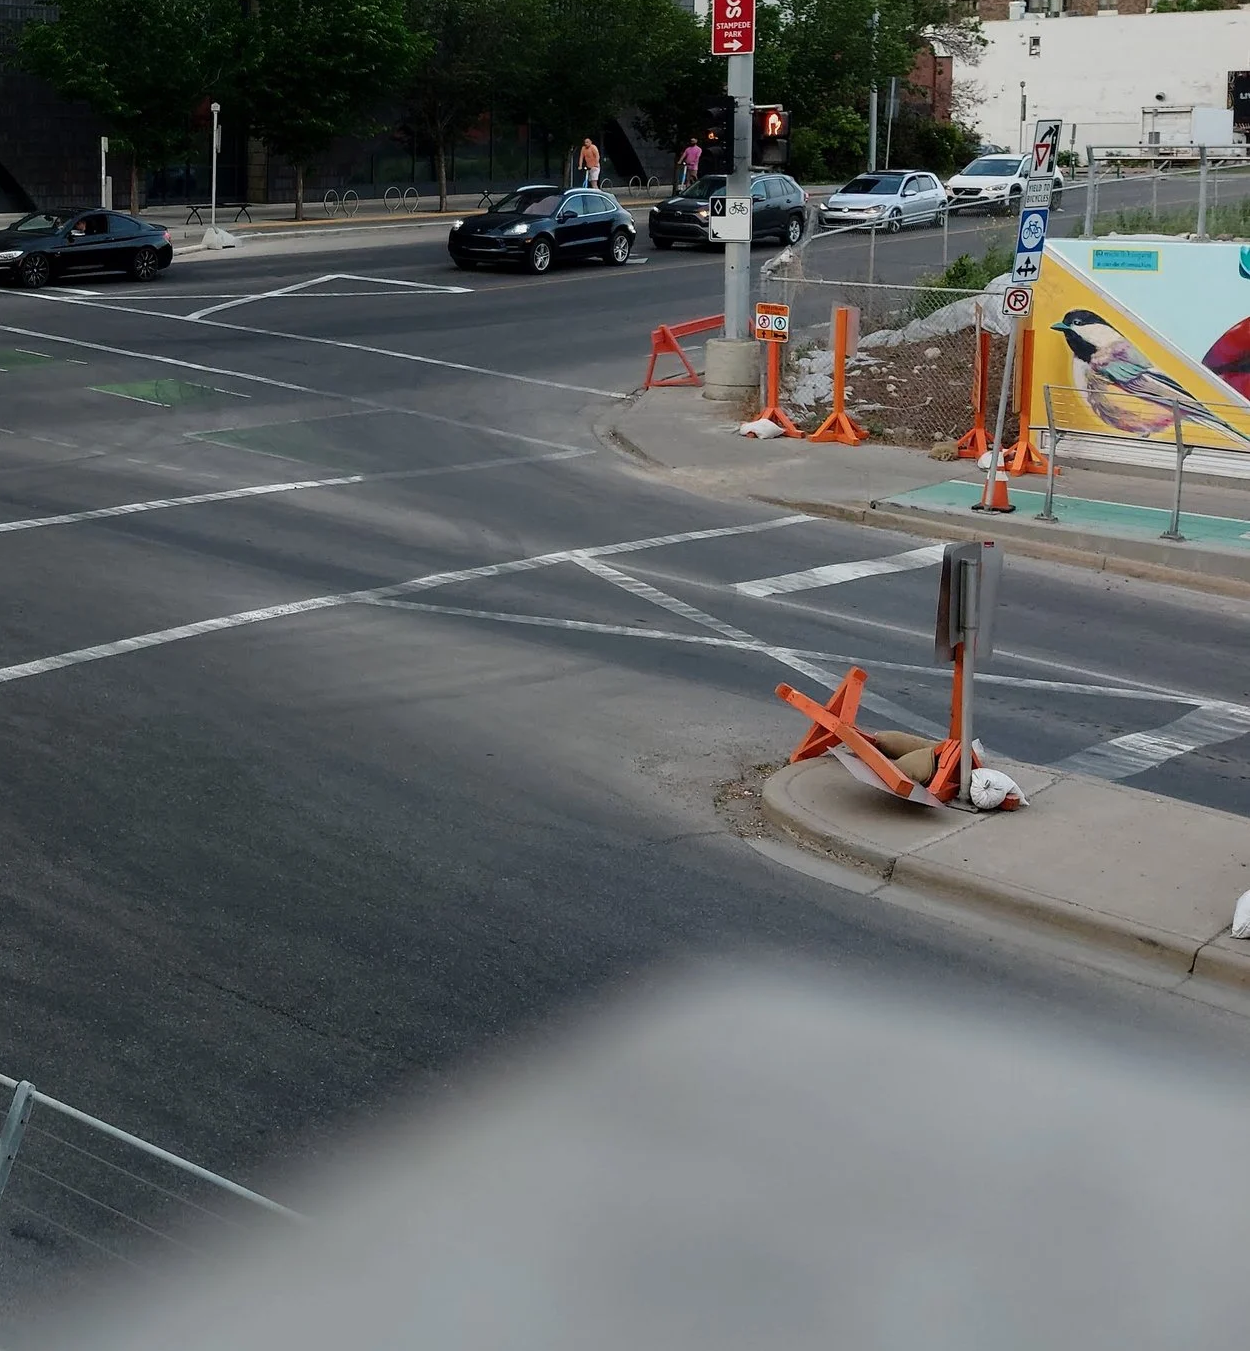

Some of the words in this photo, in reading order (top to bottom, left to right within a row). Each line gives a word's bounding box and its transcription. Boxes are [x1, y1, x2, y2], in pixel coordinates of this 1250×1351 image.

[716, 21, 752, 29] STAMPEDE
[1029, 183, 1042, 192] YIELD
[1043, 182, 1050, 191] TO
[1026, 194, 1049, 203] BICYCLES
